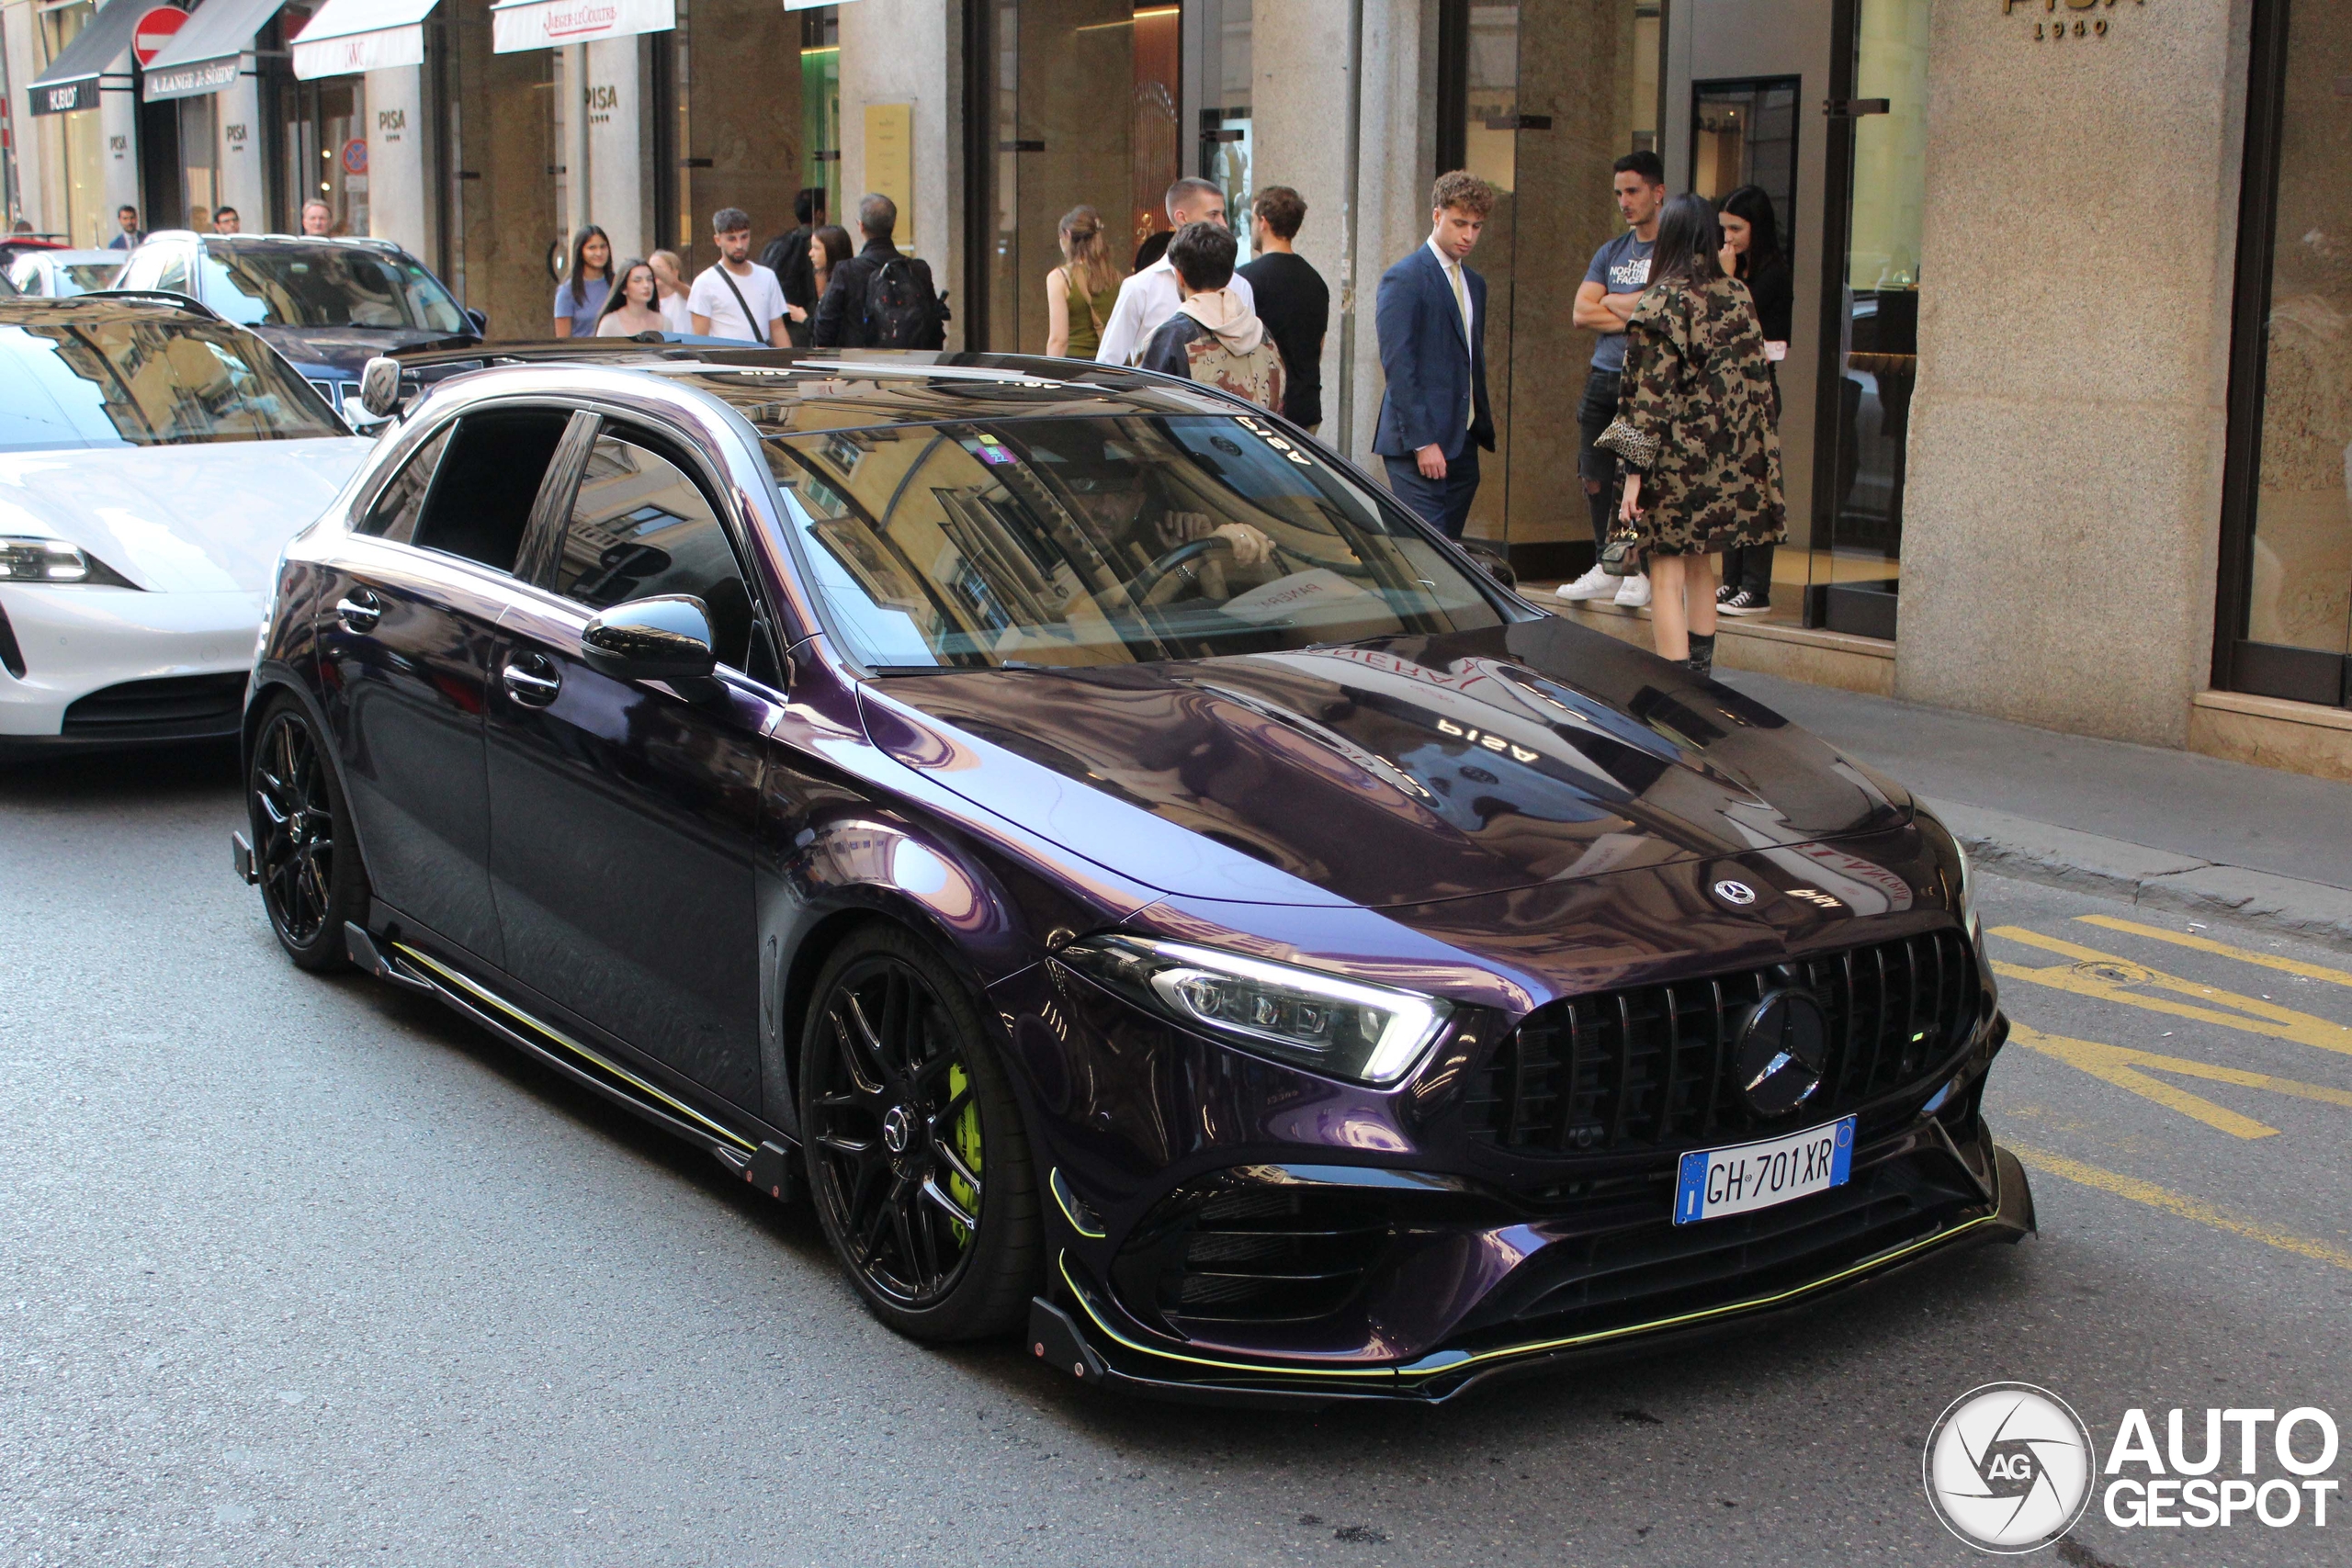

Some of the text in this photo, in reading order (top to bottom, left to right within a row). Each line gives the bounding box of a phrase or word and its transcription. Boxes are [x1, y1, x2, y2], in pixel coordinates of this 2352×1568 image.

[2034, 19, 2107, 40] 1940
[379, 109, 406, 130] PISA
[227, 124, 248, 141] PISA
[1628, 259, 1645, 269] THE
[1610, 266, 1643, 277] NORTH
[1617, 276, 1640, 285] FACE
